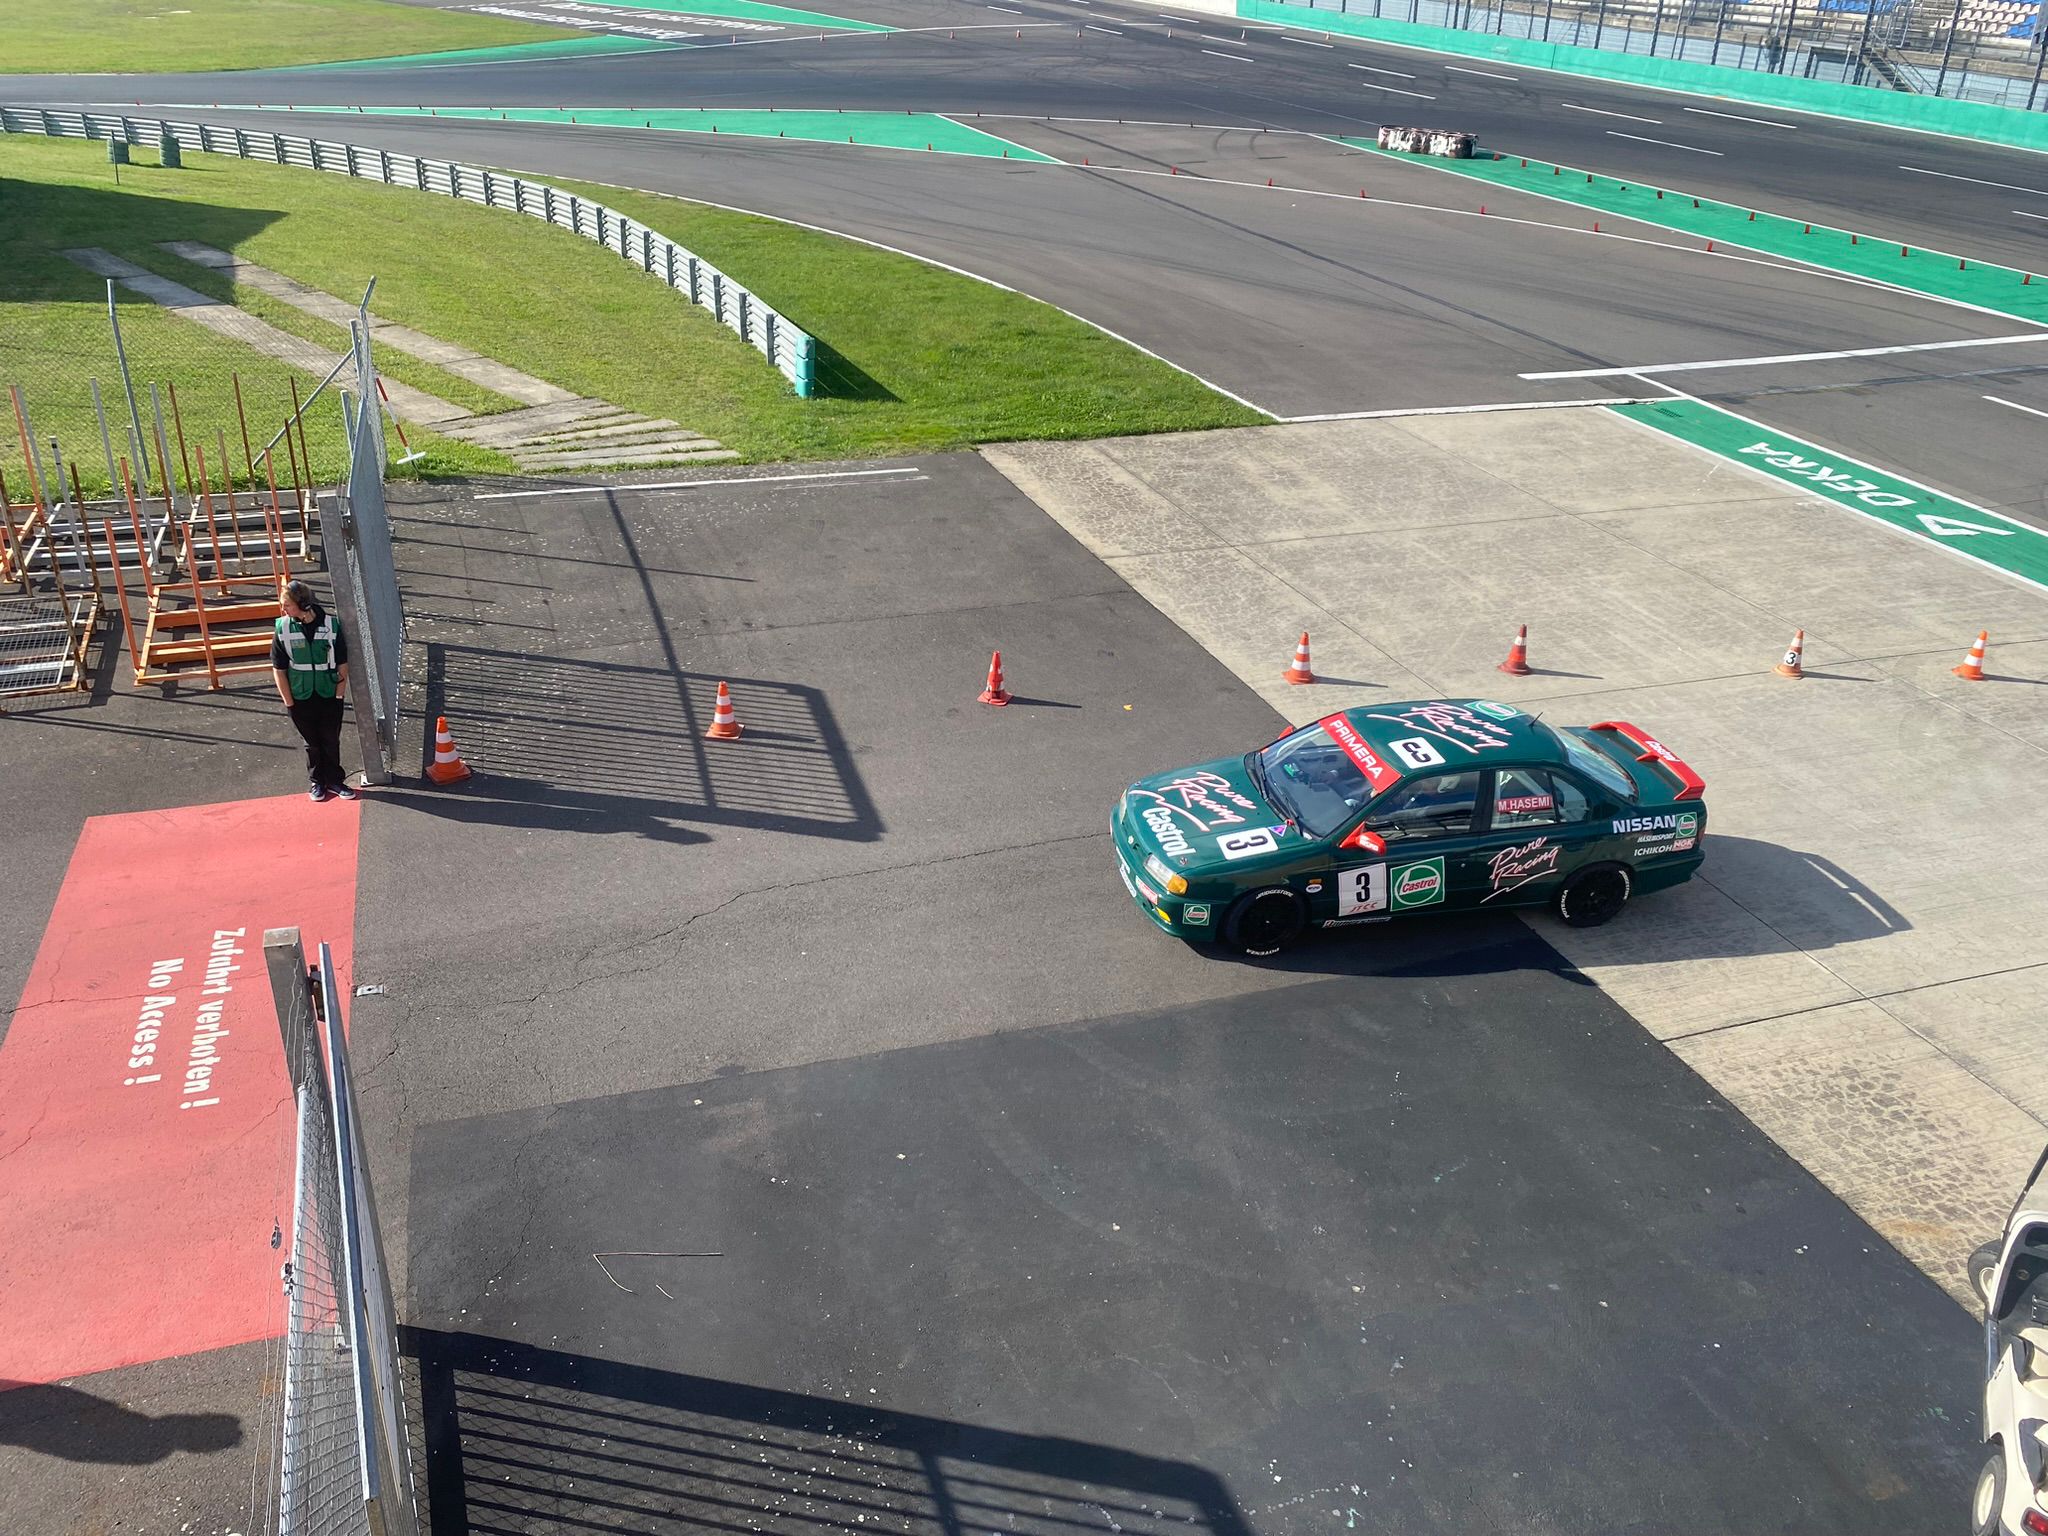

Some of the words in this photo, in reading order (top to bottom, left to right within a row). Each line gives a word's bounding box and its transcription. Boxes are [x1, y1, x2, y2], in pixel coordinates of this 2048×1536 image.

[1737, 442, 1918, 507] DEKRA
[1785, 652, 1796, 665] 3
[1399, 709, 1509, 748] Racing
[1411, 702, 1513, 736] Pure
[1328, 719, 1384, 779] PRIMERA
[1401, 741, 1432, 763] 3
[1157, 782, 1246, 825] Racing
[1172, 771, 1257, 810] Pure
[1497, 796, 1550, 812] M.HASEMI
[1141, 806, 1197, 858] Castrol
[1612, 814, 1677, 834] NISSAN
[1225, 834, 1269, 851] 3
[1487, 836, 1548, 880] Pure
[1401, 877, 1438, 893] Castrol
[1493, 846, 1559, 890] Racing
[1355, 872, 1371, 903] 3
[147, 957, 185, 989] No
[201, 927, 246, 995] Zufahrt
[127, 996, 177, 1069] Access
[183, 999, 230, 1095] verboten
[123, 1073, 162, 1086] !
[179, 1097, 220, 1110] !
